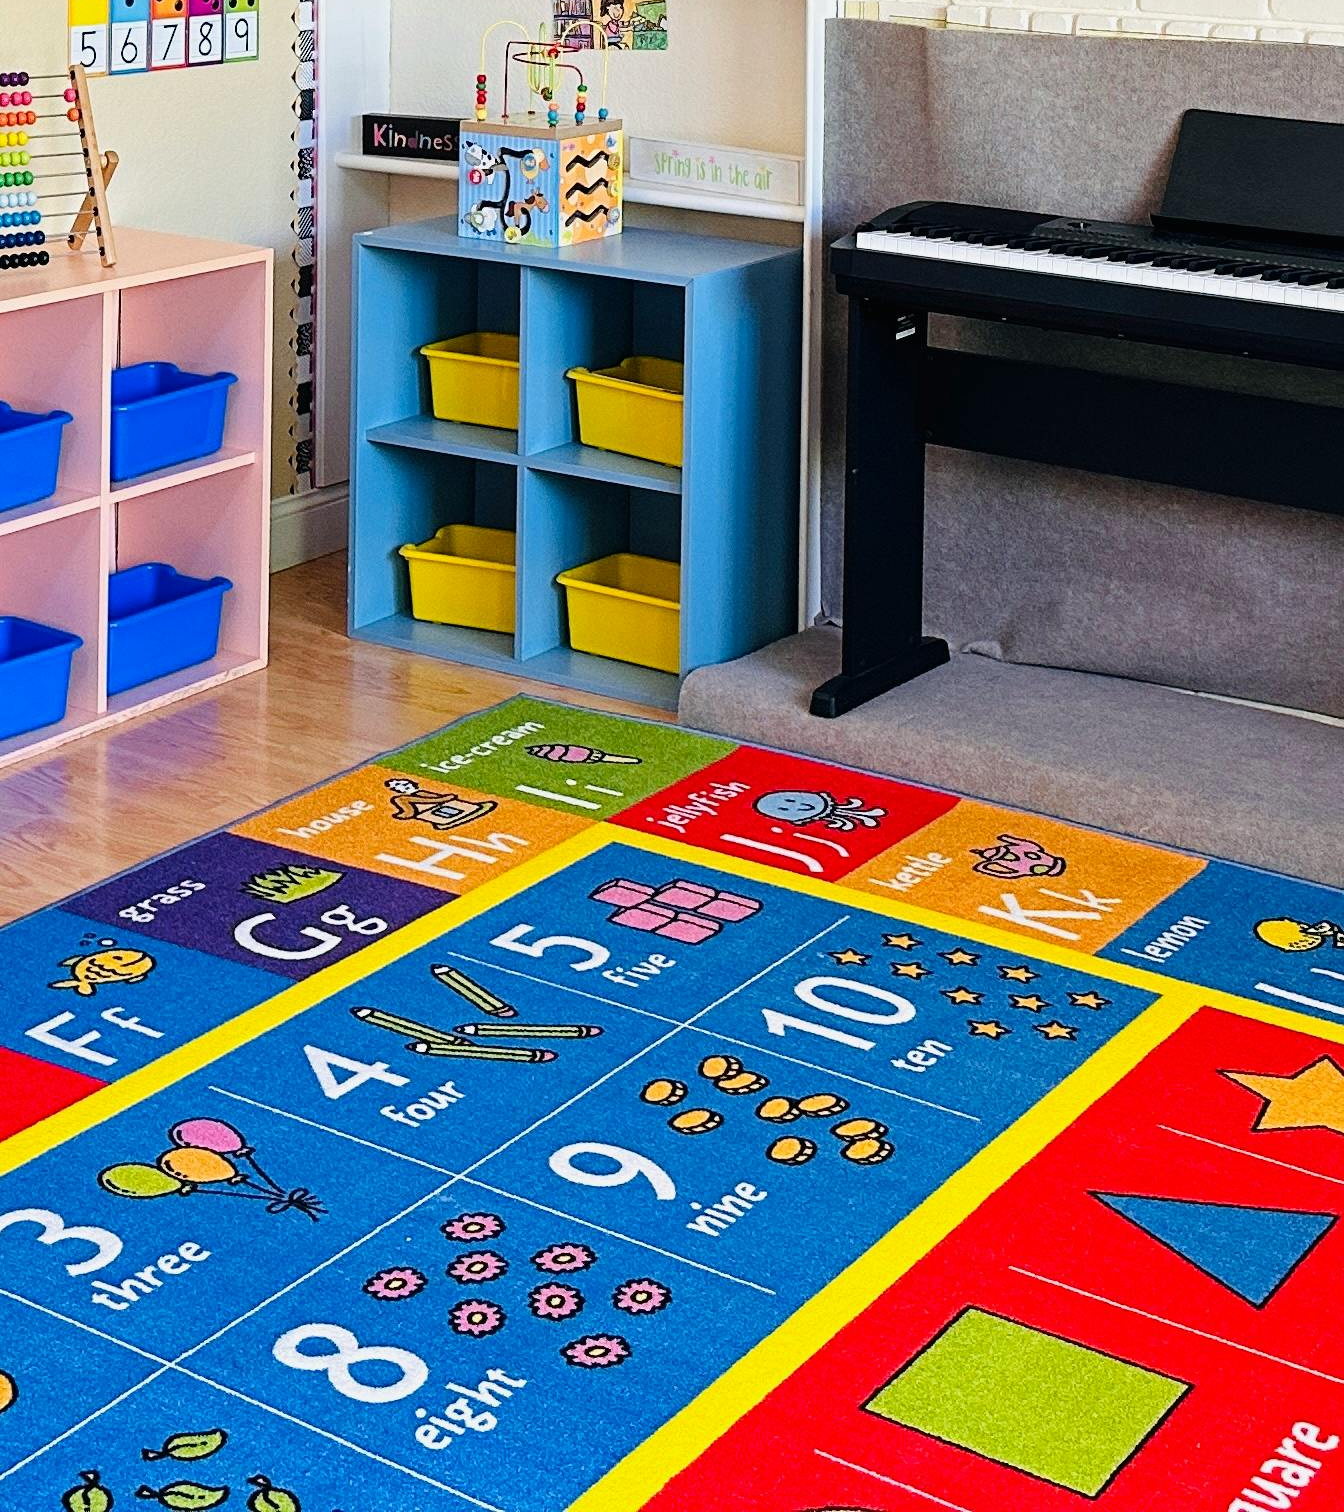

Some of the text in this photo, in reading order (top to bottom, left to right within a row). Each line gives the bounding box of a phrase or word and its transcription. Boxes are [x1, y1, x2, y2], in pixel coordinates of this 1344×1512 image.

[729, 164, 750, 188] the
[419, 719, 545, 776] ice-cream
[277, 796, 375, 841] house
[646, 777, 751, 833] jellyfish
[868, 847, 953, 894] kettle
[118, 877, 206, 924] grass
[488, 922, 611, 972] 5
[1120, 914, 1210, 967] lemon
[600, 948, 677, 991] five
[759, 975, 917, 1052] 10
[302, 1042, 411, 1100] 4
[891, 1036, 953, 1075] ten
[379, 1078, 465, 1129] four
[548, 1140, 677, 1201] 9
[687, 1178, 768, 1239] nine
[88, 1234, 213, 1315] three
[271, 1319, 430, 1405] 8
[415, 1364, 527, 1454] eight
